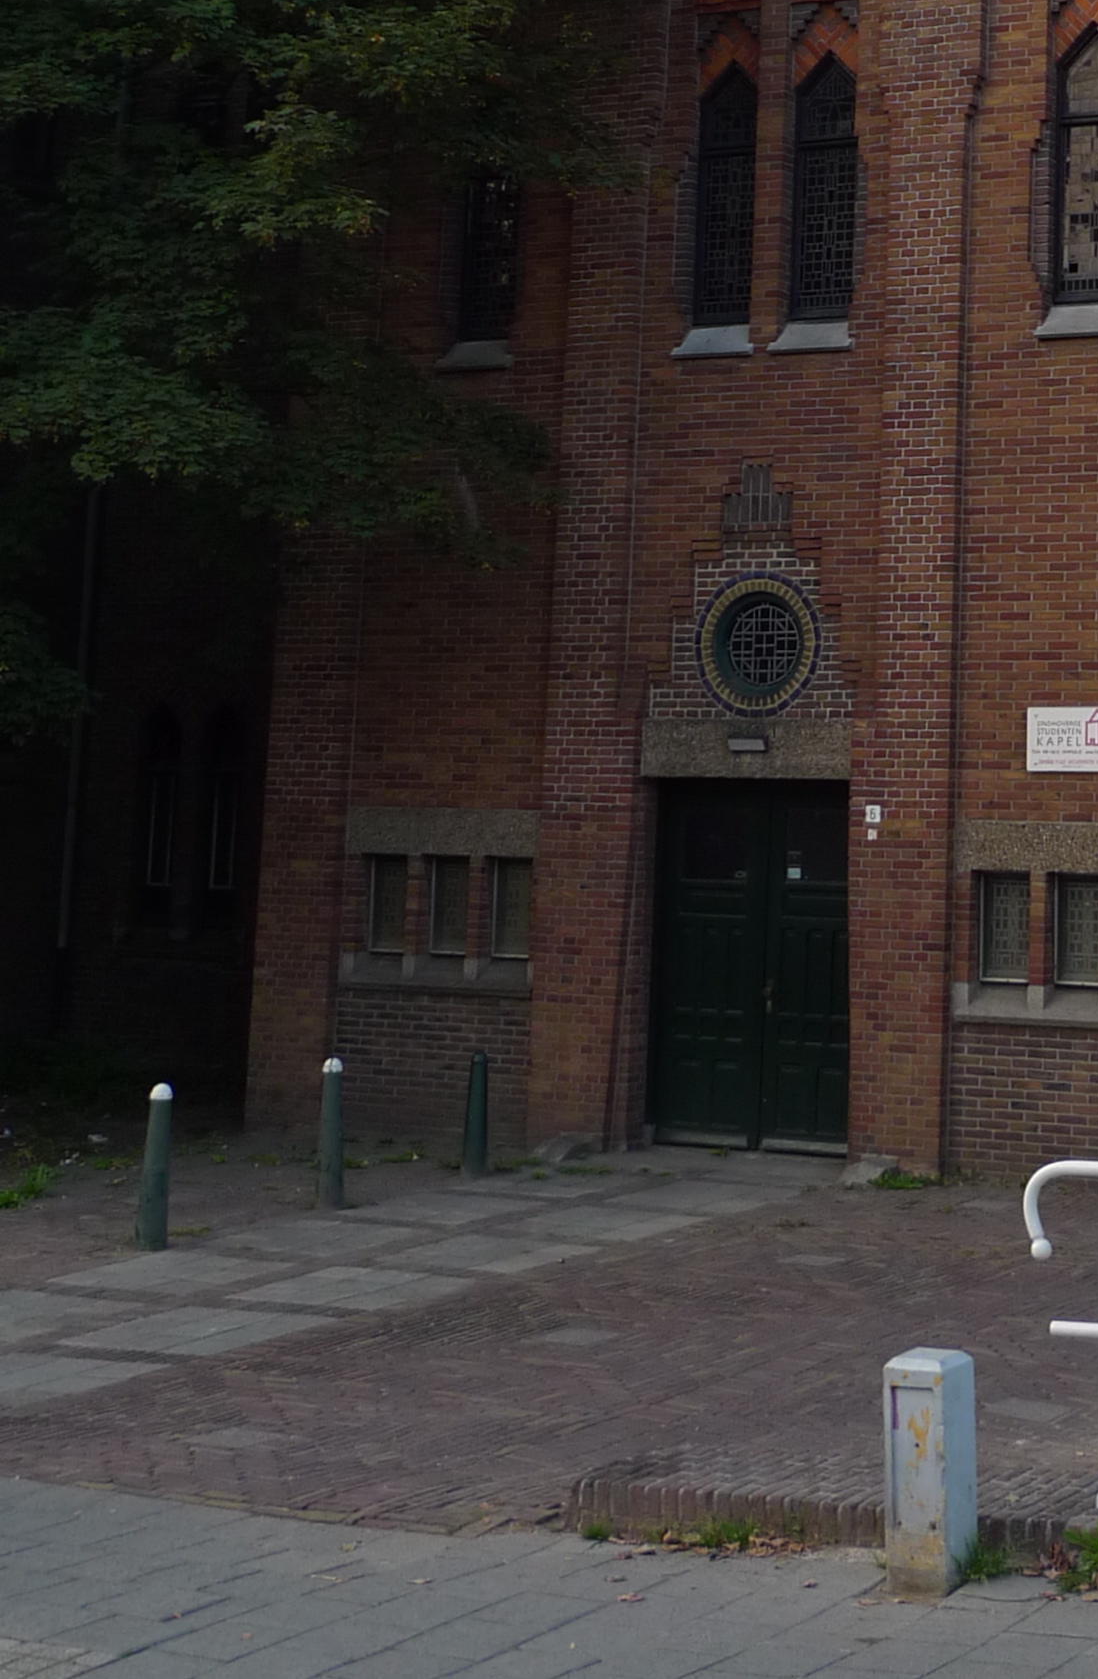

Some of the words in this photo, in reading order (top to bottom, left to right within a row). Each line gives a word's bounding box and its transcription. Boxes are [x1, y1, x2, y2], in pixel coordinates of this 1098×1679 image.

[1037, 727, 1082, 735] STUDENTEN
[1037, 736, 1082, 746] KAPEL
[870, 808, 876, 820] 6
